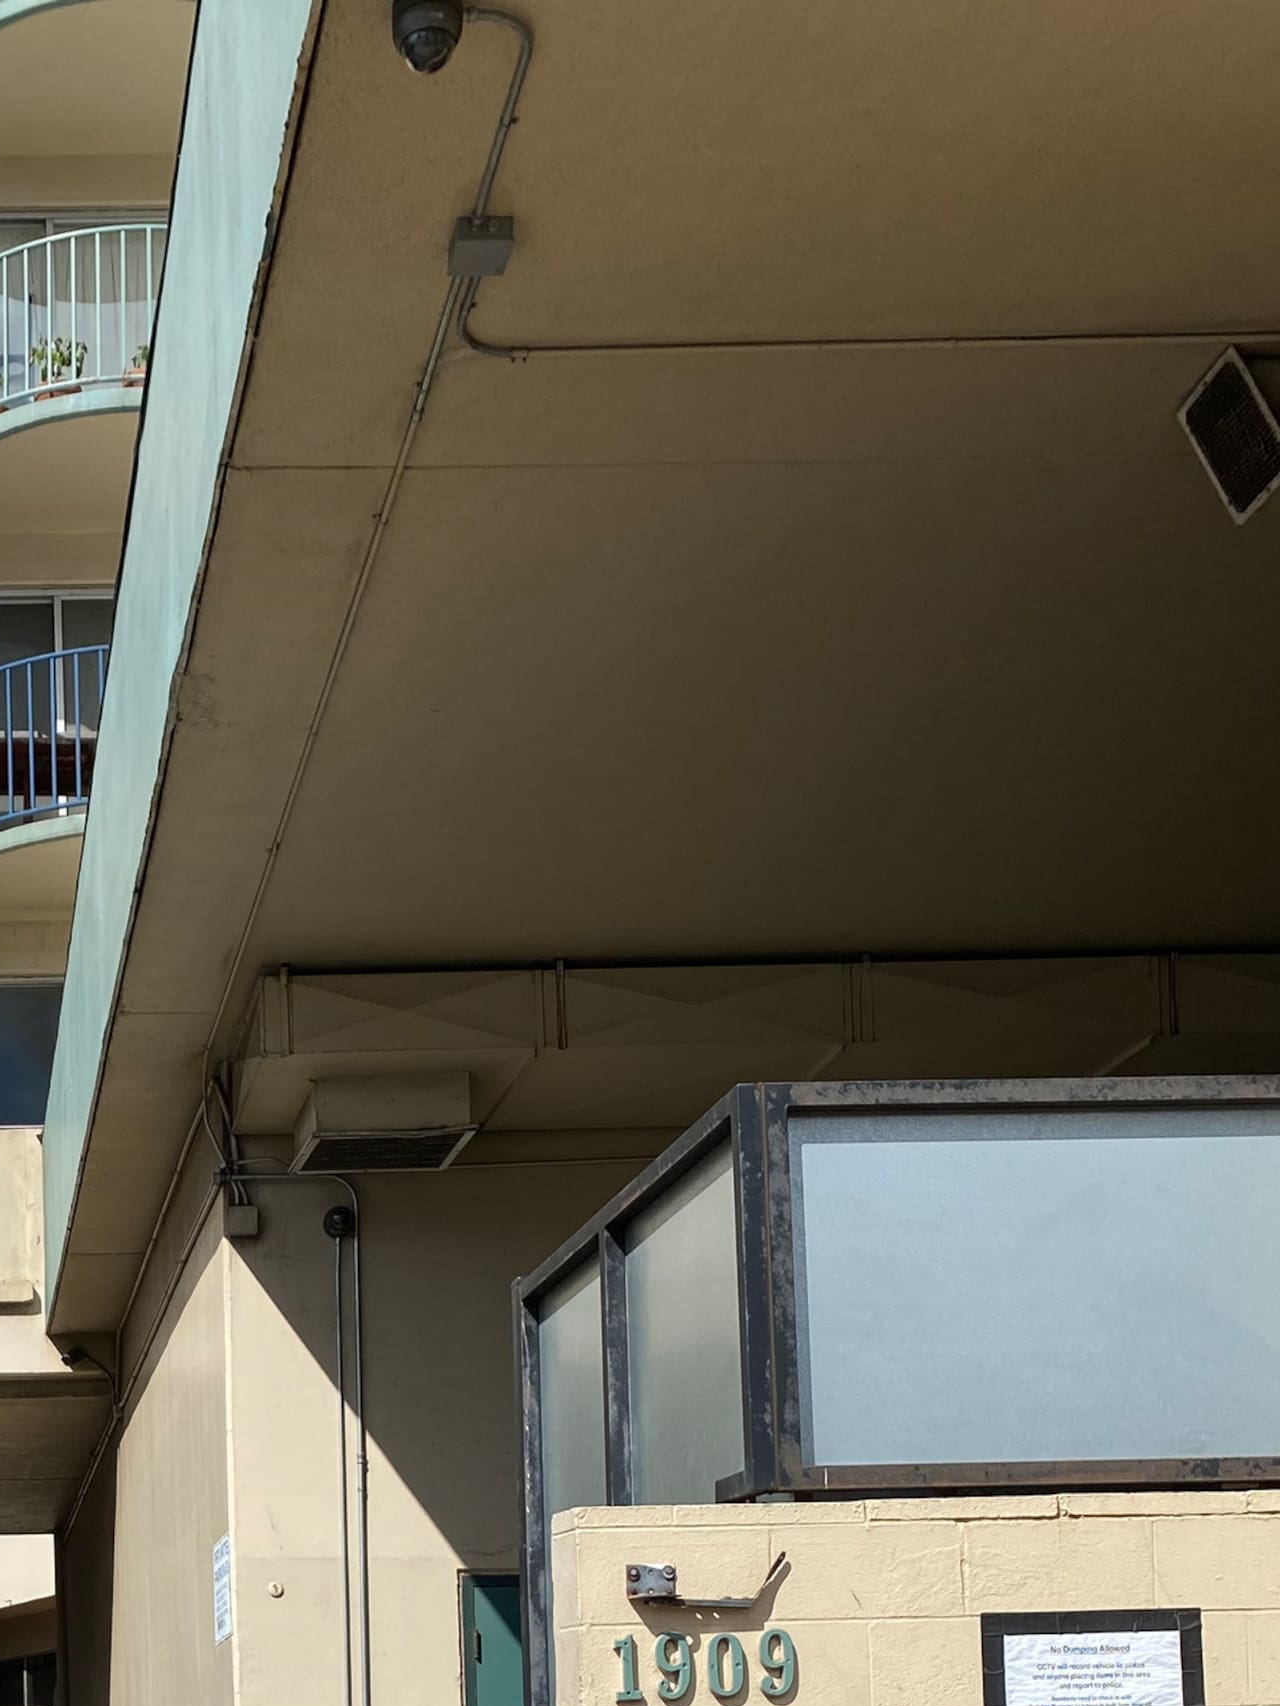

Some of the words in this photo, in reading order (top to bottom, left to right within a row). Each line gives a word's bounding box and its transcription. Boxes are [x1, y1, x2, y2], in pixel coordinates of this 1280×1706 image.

[613, 1628, 796, 1701] 1909
[1050, 1645, 1061, 1654] No
[1063, 1645, 1098, 1655] Dumping
[1100, 1644, 1130, 1653] Allowed
